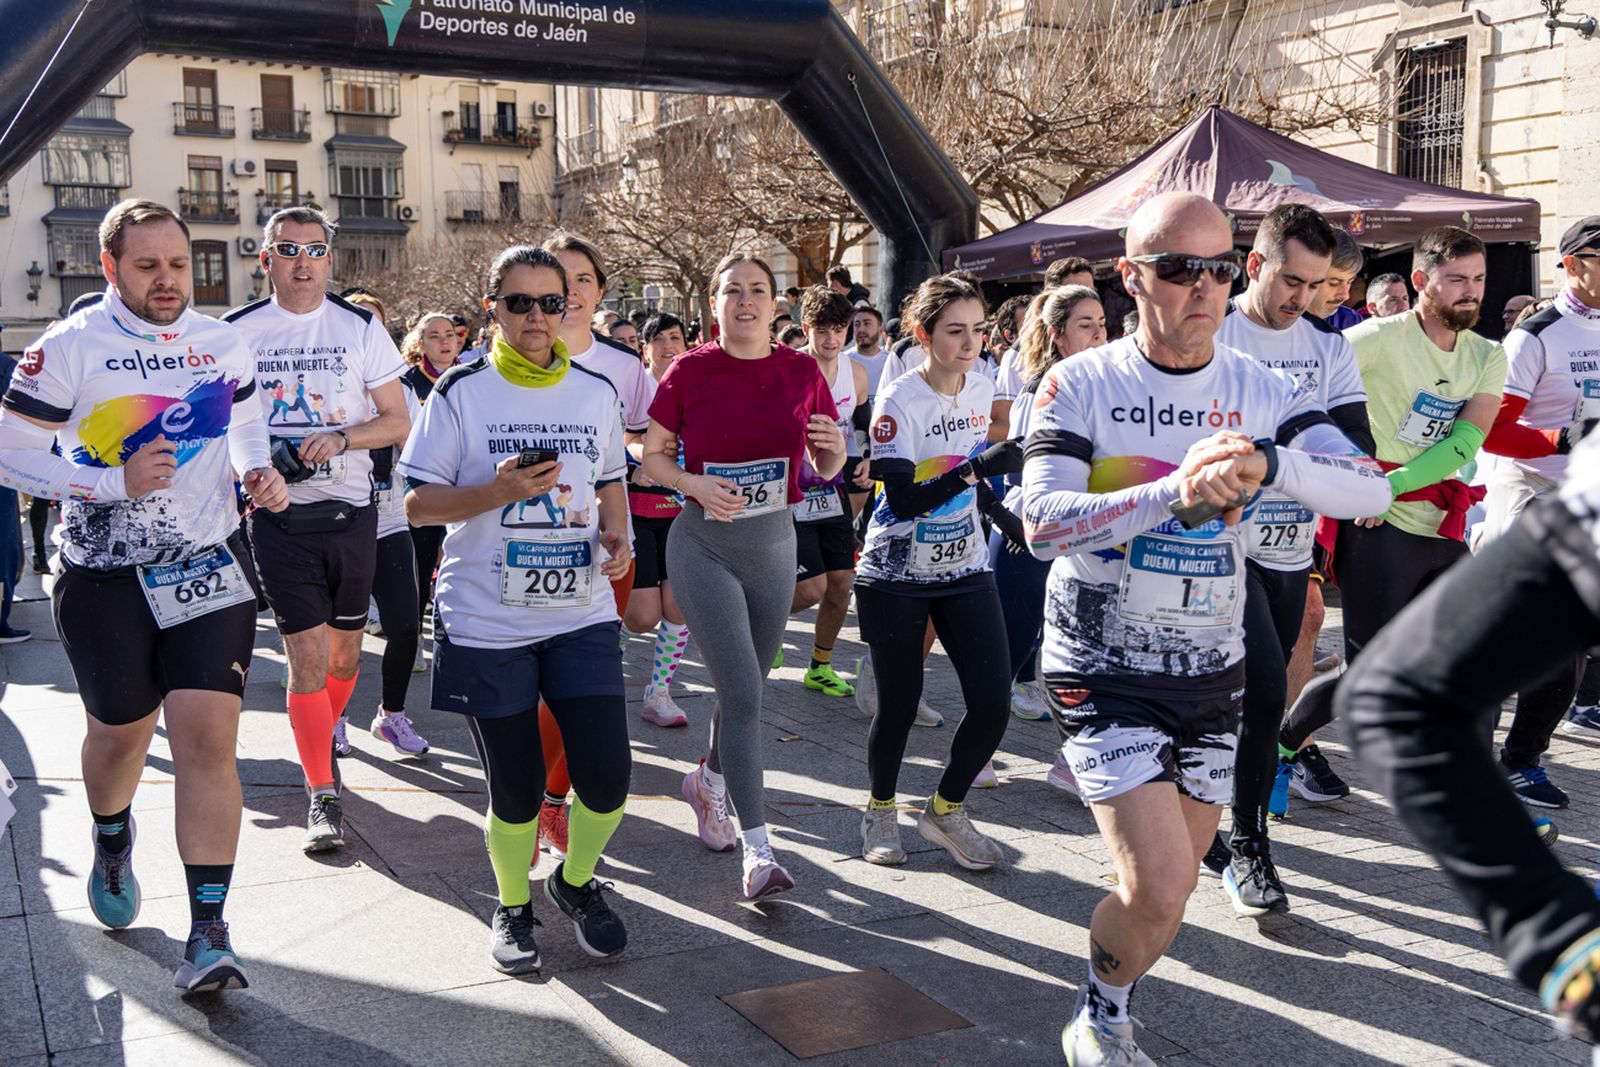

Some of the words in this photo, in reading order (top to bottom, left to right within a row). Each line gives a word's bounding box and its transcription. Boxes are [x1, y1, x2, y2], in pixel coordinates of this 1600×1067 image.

[520, 0, 607, 24] Municipal
[613, 7, 636, 25] de
[420, 11, 508, 36] Deportes
[513, 21, 538, 39] de
[543, 23, 588, 43] Jaén
[267, 348, 305, 357] CARRERA
[307, 346, 347, 355] CAMINATA
[257, 361, 289, 373] BUENA
[292, 358, 329, 372] MUERTE
[1274, 360, 1319, 368] CAMINATA
[1570, 361, 1599, 372] BUENA
[486, 424, 497, 433] VI
[500, 423, 548, 433] CARRERA
[550, 423, 597, 436] CAMINATA
[488, 438, 525, 454] BUENA
[533, 439, 582, 454] MUERTE
[806, 496, 829, 512] 718
[1259, 524, 1298, 547] 279
[526, 545, 556, 553] CARRERA
[930, 538, 967, 562] 349
[1145, 541, 1155, 550] VI
[1156, 543, 1195, 556] CARRERA
[516, 554, 542, 566] BUENA
[544, 555, 573, 566] MUERTE
[1142, 553, 1176, 570] BUENA
[1178, 559, 1217, 574] MUERTE
[175, 572, 227, 603] 682
[524, 569, 577, 594] 202
[1181, 578, 1192, 608] 1
[1075, 754, 1097, 774] club
